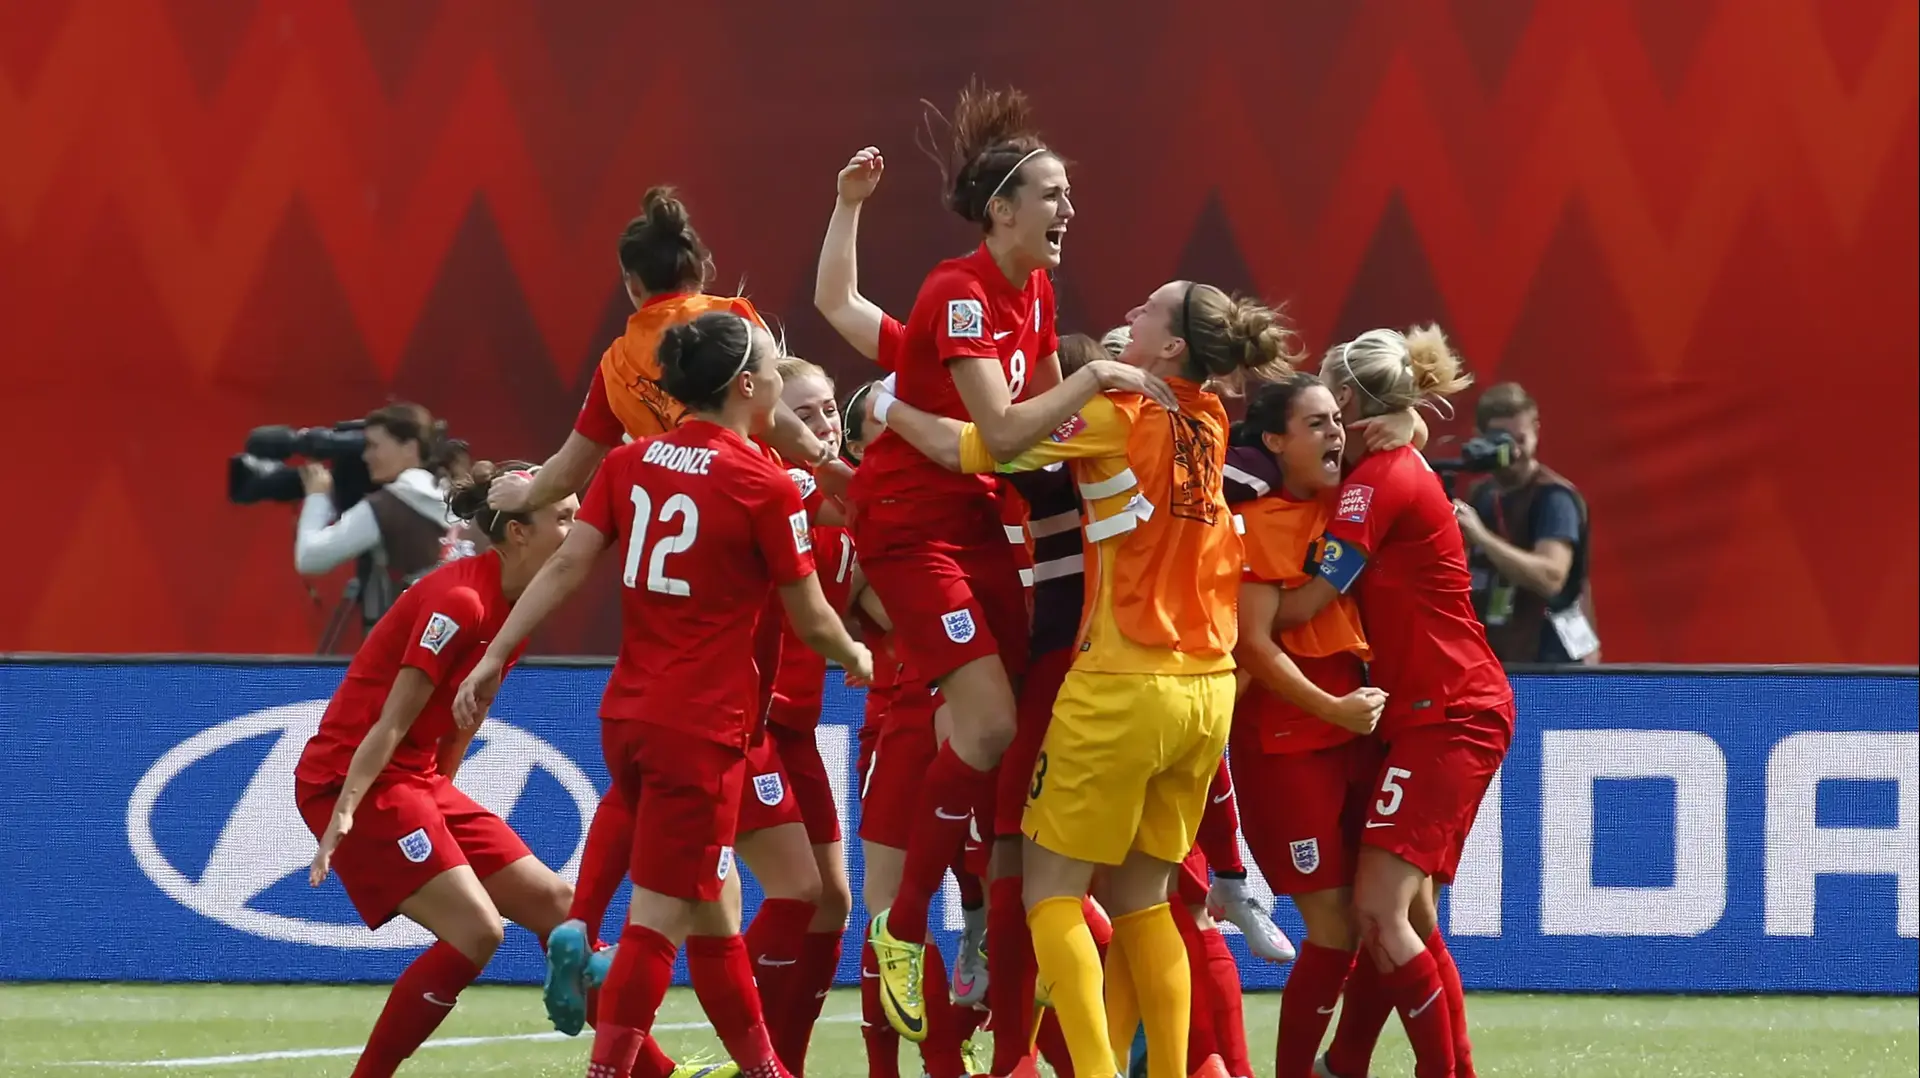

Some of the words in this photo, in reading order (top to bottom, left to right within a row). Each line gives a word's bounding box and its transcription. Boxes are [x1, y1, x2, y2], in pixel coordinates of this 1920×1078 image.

[1009, 349, 1026, 400] 8
[642, 441, 719, 476] BRONZE
[1340, 496, 1364, 507] YOUR
[623, 484, 699, 597] 12
[836, 532, 857, 583] 1
[1376, 766, 1412, 816] 5
